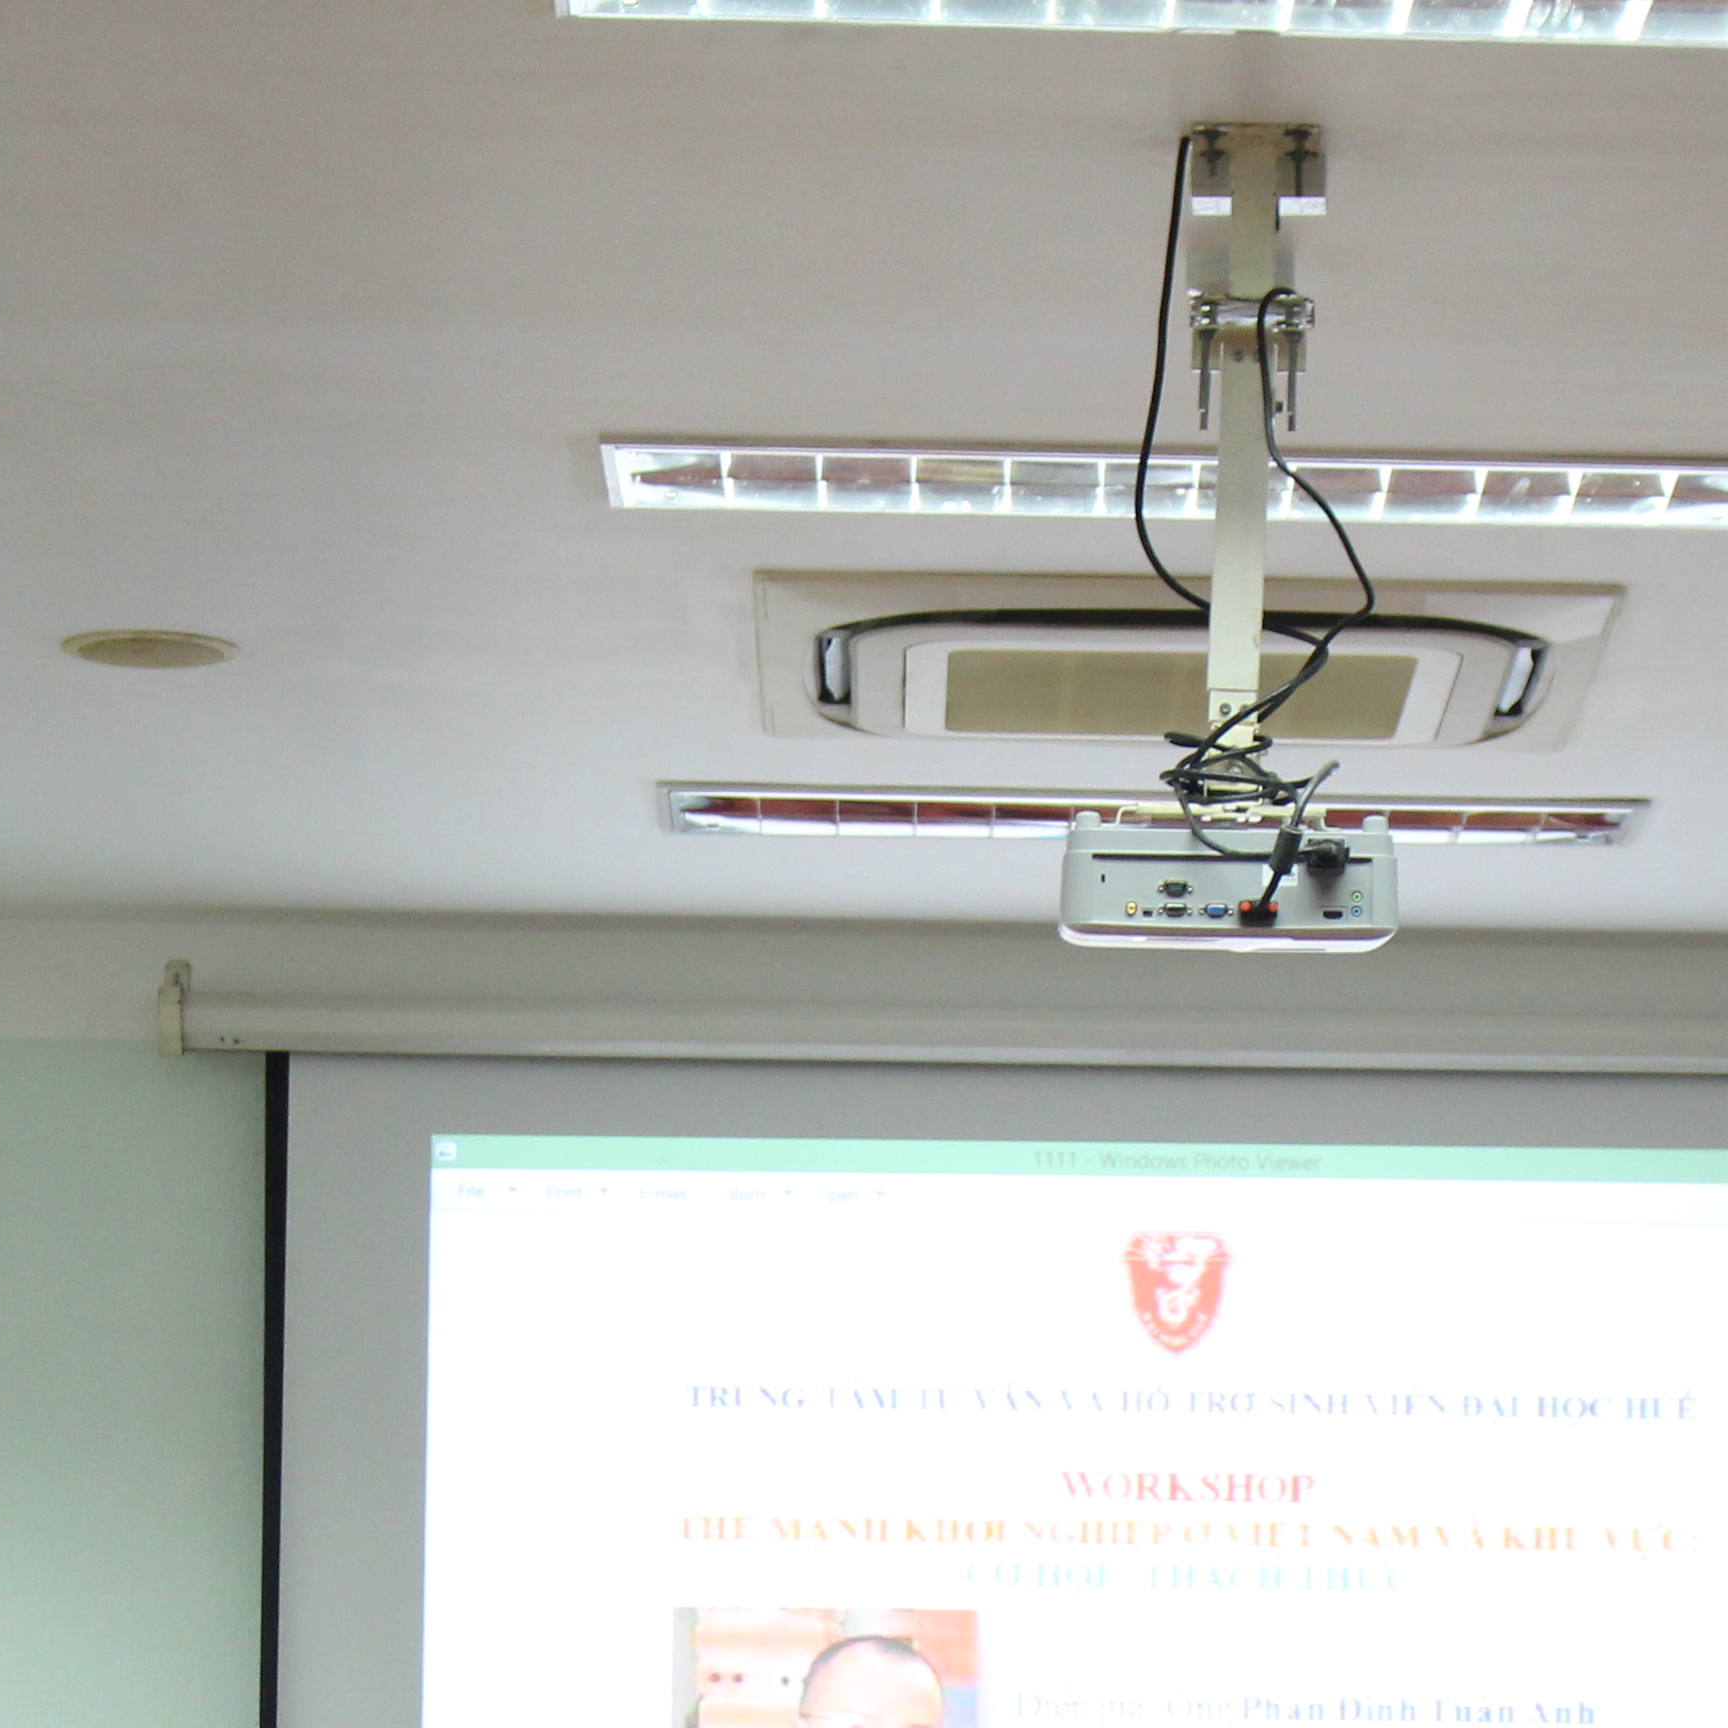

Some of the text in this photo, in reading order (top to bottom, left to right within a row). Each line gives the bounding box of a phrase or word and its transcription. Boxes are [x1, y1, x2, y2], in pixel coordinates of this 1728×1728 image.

[1099, 1151, 1187, 1169] Windows
[1193, 1153, 1250, 1171] Photo
[1256, 1154, 1322, 1172] Viewer
[1062, 1472, 1316, 1504] WORKSHOP
[1244, 1698, 1327, 1722] Phan
[1528, 1702, 1598, 1725] Anh
